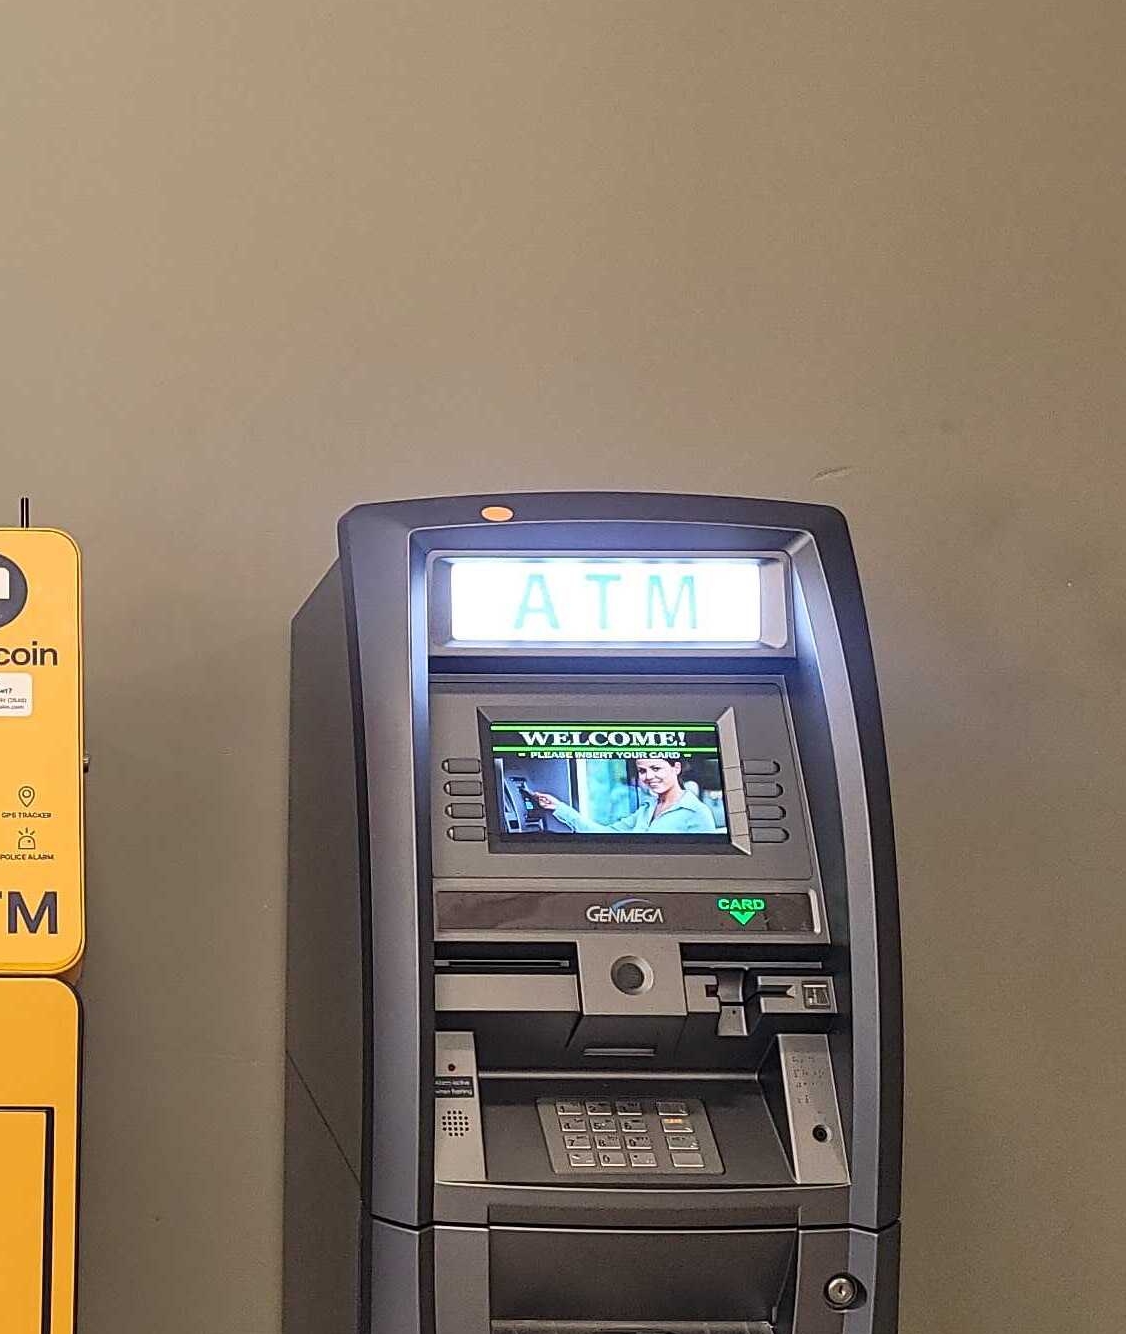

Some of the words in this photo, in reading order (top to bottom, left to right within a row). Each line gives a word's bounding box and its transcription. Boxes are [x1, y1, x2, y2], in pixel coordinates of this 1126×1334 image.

[514, 573, 699, 630] ATM
[519, 731, 687, 747] WELCOME!
[718, 898, 766, 910] CARD
[586, 905, 664, 924] GENMEGA
